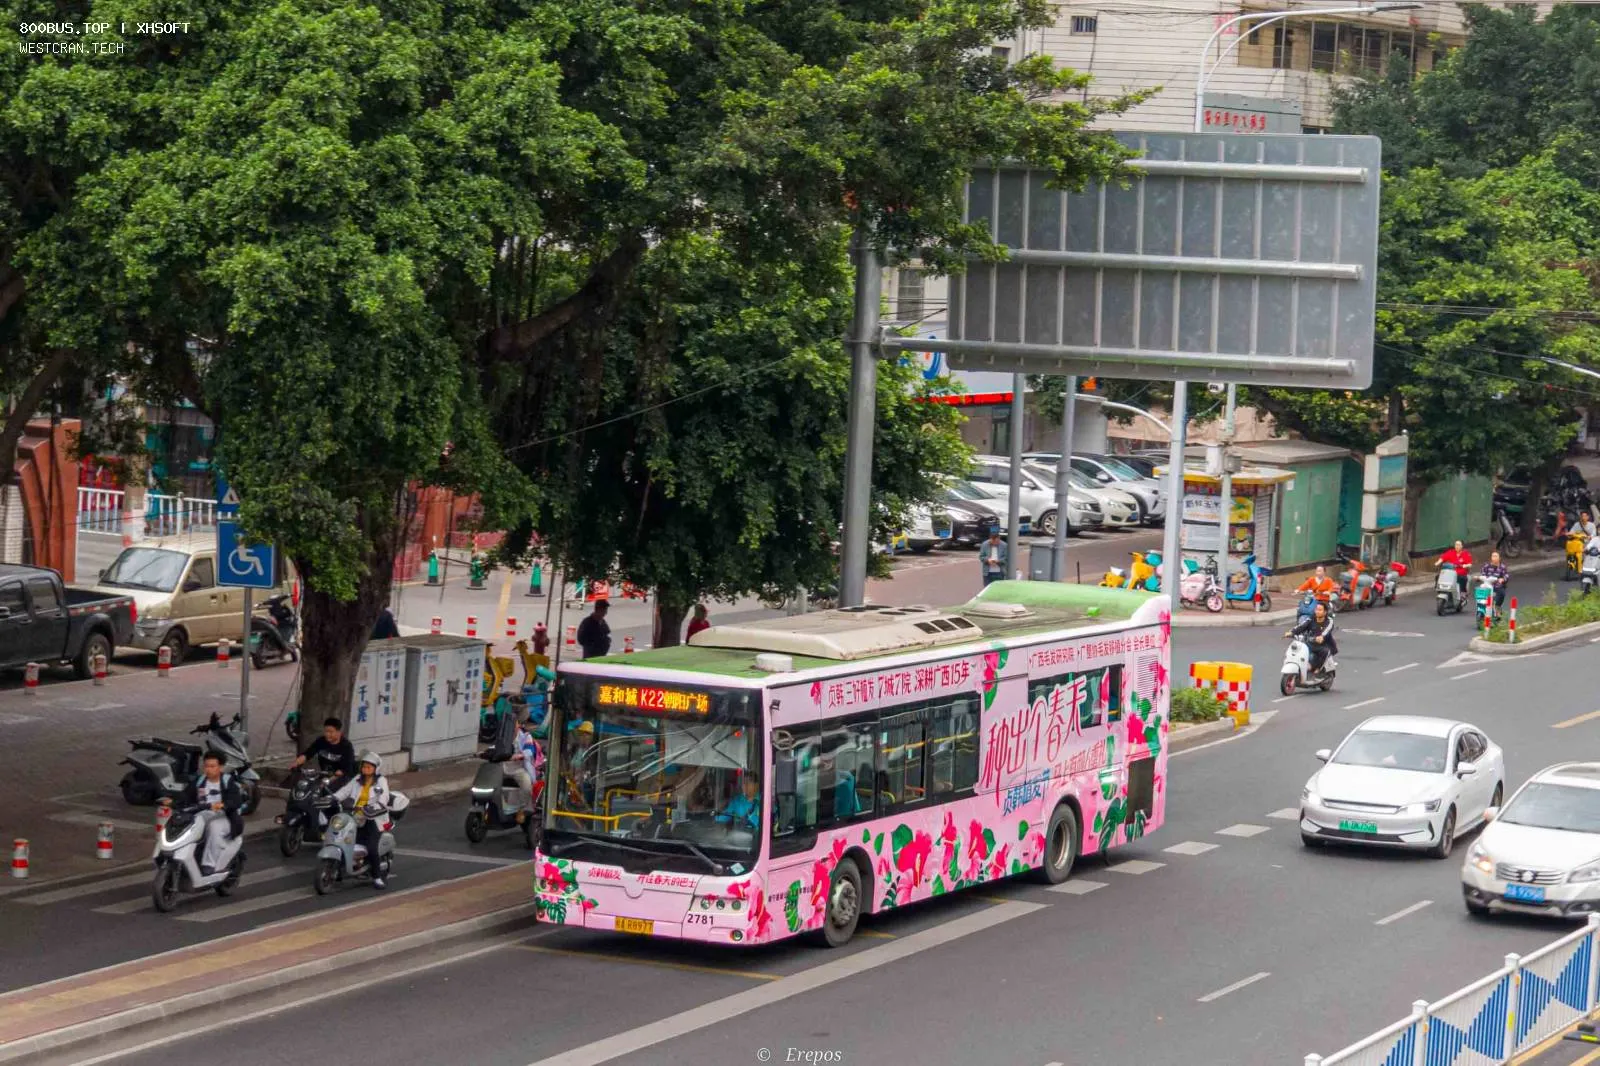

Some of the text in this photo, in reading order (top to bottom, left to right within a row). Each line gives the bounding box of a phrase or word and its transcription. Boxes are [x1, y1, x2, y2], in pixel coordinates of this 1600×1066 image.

[914, 659, 970, 692] 深耕广西15年
[599, 685, 709, 713] 嘉和城 K22 朝阳广场
[981, 679, 1086, 808] 种出个春天
[636, 873, 697, 888] 开往春天的巴士
[687, 913, 714, 925] 2781
